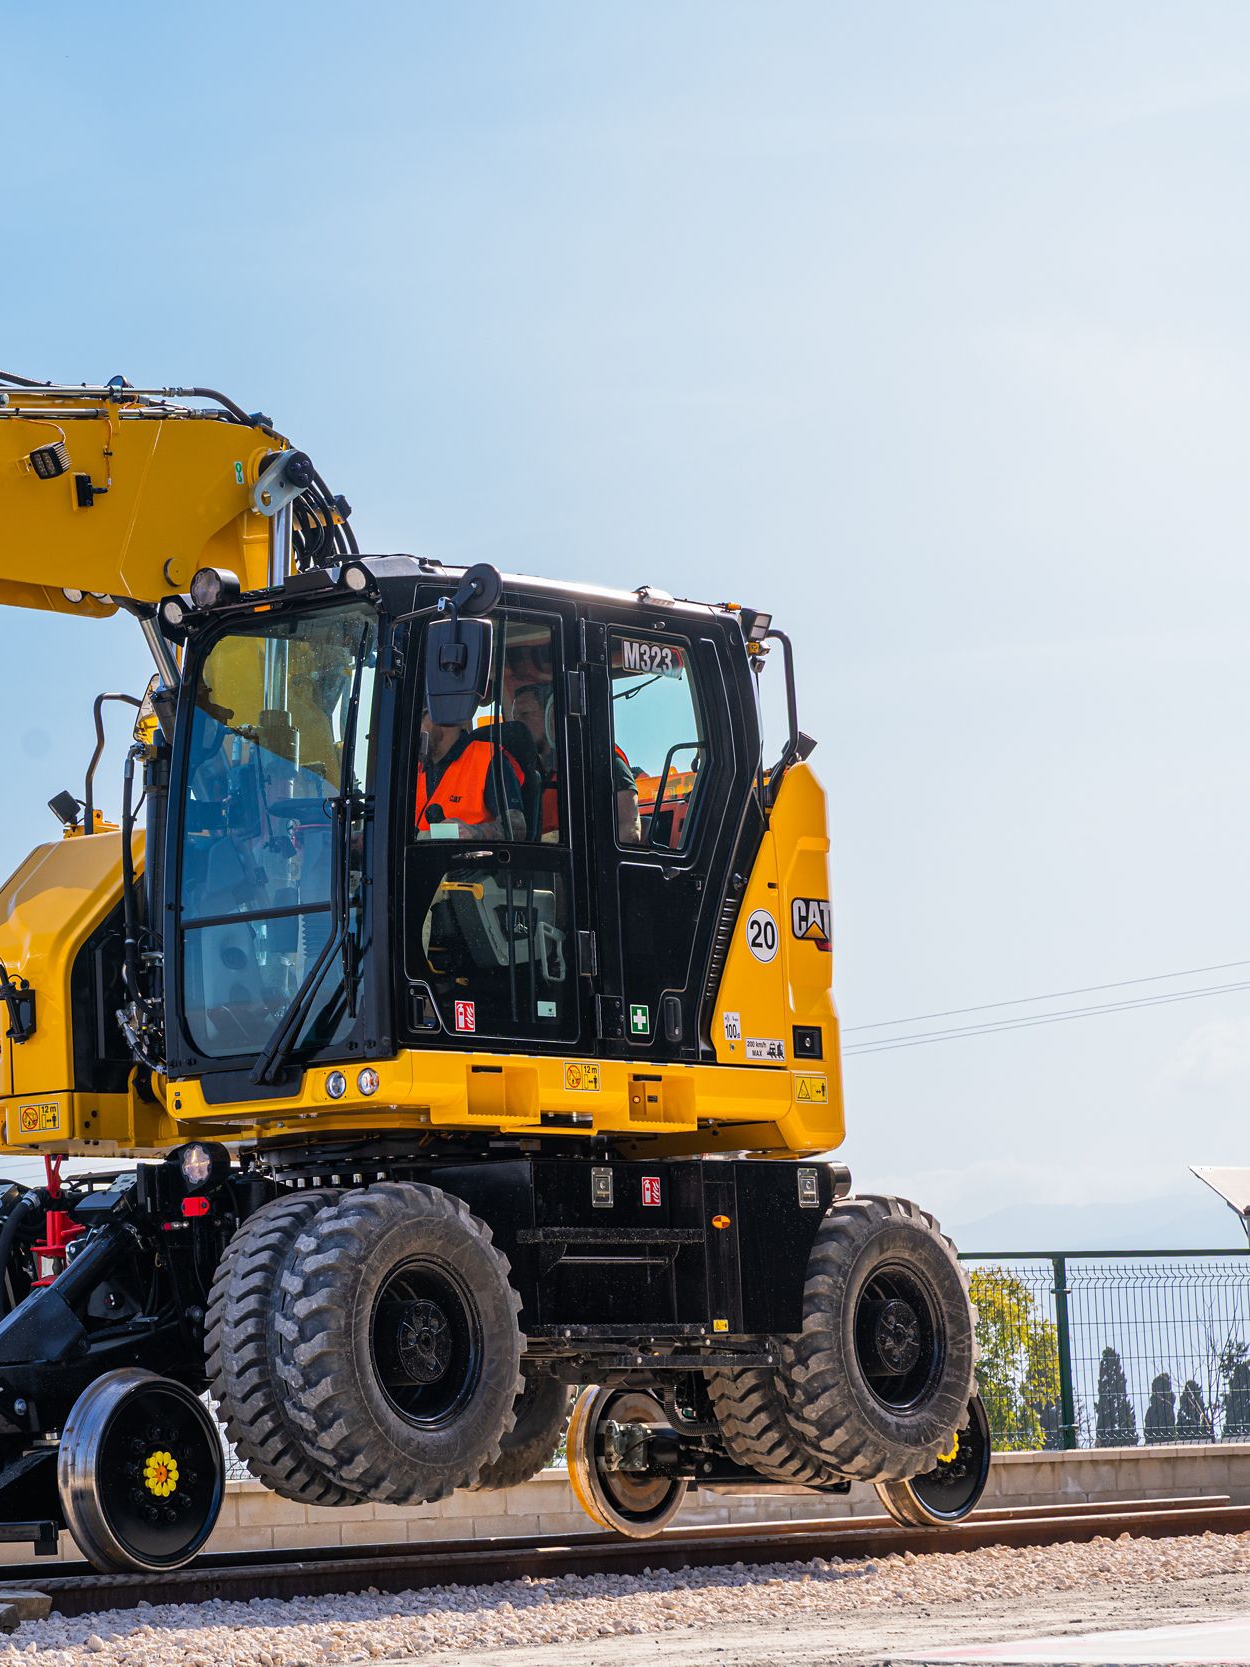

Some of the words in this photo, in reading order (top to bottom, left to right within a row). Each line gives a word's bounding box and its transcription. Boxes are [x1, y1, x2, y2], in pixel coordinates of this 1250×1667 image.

[623, 640, 674, 676] M323
[792, 899, 831, 940] CAT
[749, 918, 776, 951] 20
[725, 1023, 738, 1039] 100
[756, 1041, 767, 1049] km/h
[583, 1065, 591, 1074] 12
[41, 1105, 49, 1114] 12
